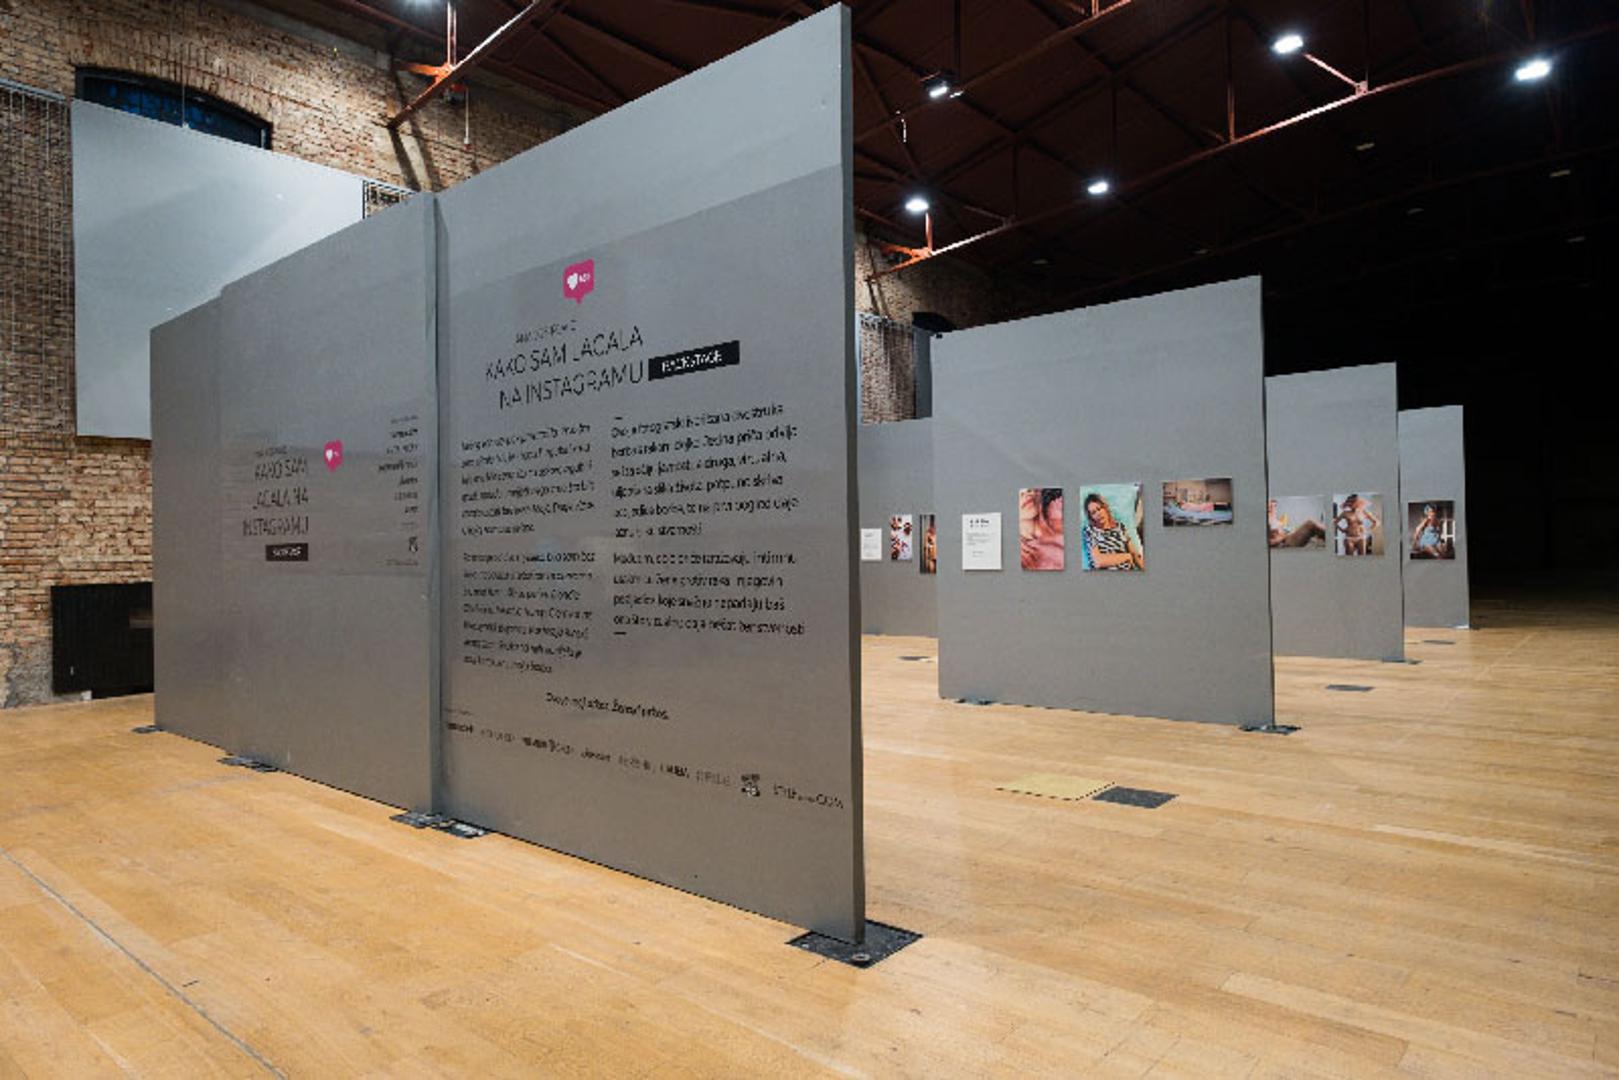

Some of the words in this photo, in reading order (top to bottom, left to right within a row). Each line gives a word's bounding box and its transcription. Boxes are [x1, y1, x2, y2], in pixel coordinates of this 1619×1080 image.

[486, 354, 526, 381] KAKO
[530, 343, 566, 371] SAM
[499, 388, 523, 410] NA
[526, 361, 643, 403] INSTAGRAMU
